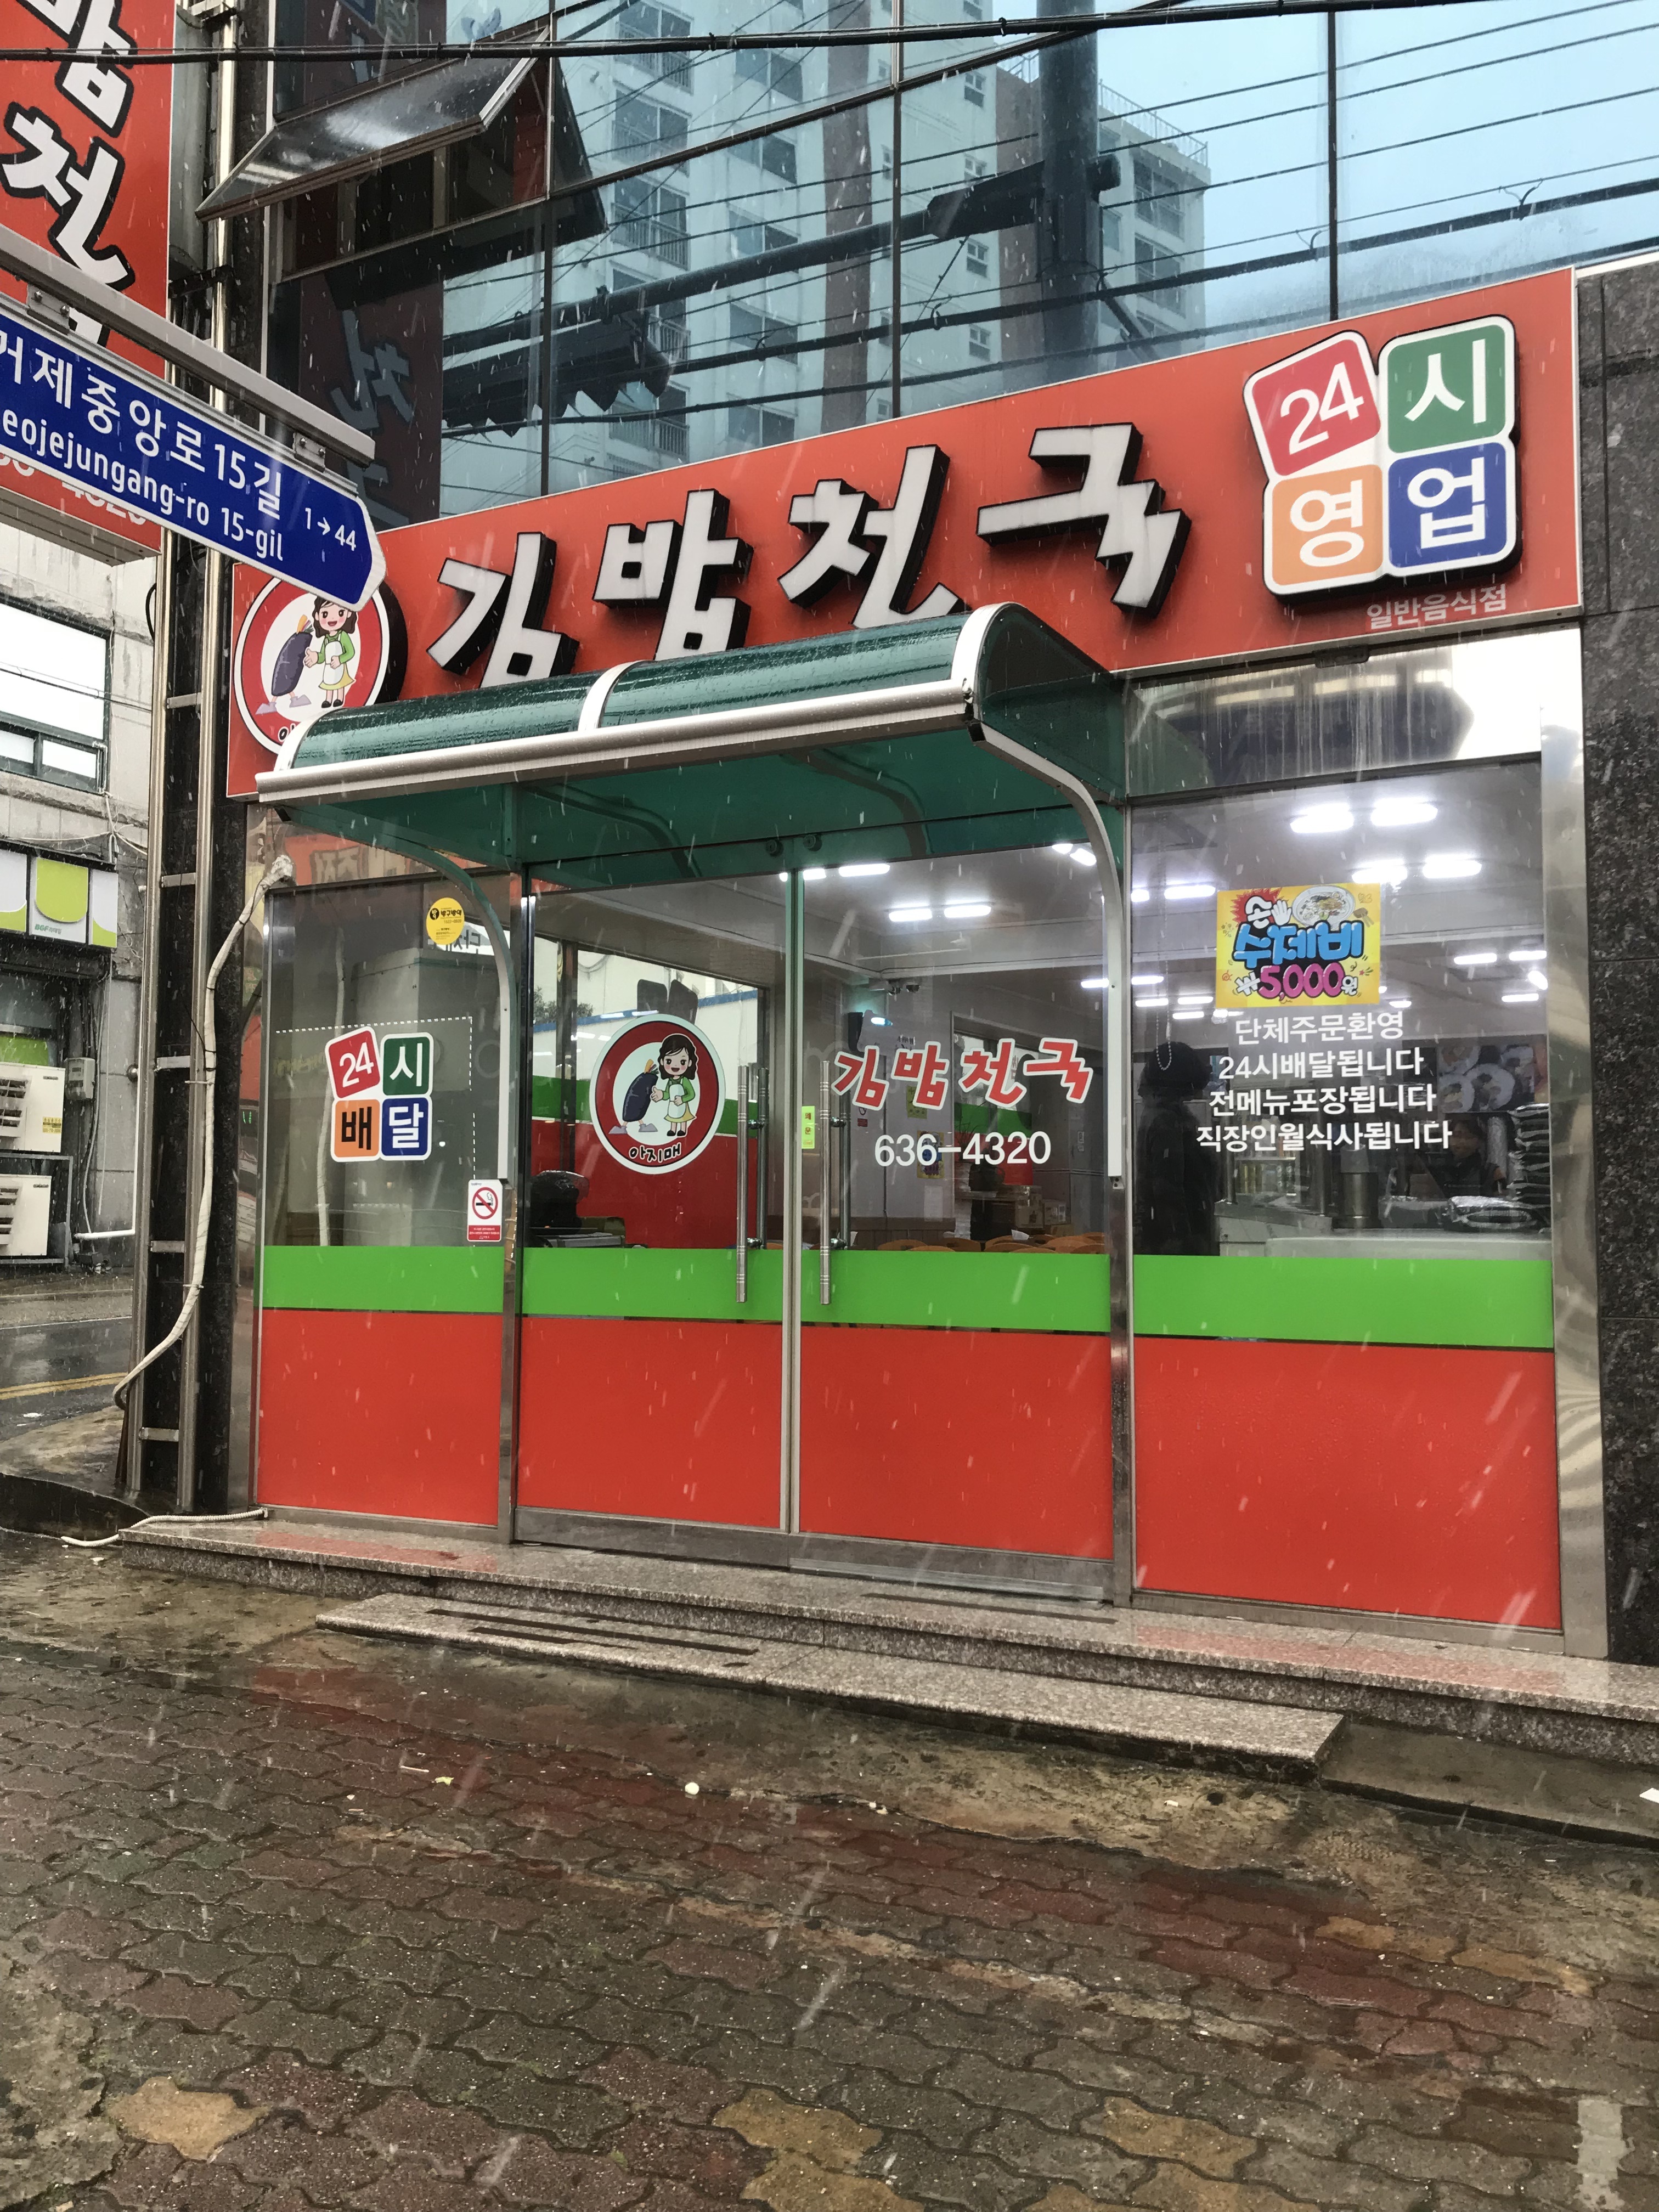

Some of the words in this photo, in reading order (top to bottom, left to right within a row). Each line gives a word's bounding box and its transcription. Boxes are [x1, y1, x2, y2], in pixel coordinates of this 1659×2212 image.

[2, 0, 132, 343] 밥천
[221, 506, 284, 562] 15-gil
[1290, 457, 1485, 567] 영업
[426, 422, 1192, 688] 김밥천국
[1367, 584, 1506, 629] 일반음식점
[1246, 895, 1272, 929] 손
[1234, 922, 1362, 968] 수제비
[1235, 1011, 1403, 1045] 단체주문환영
[832, 1037, 1093, 1110] 김밥천국
[1218, 1048, 1424, 1080] 24시배달됩니다
[1208, 1083, 1437, 1118] 전메뉴포장됩니다
[341, 1103, 424, 1150] 배달
[875, 1131, 1051, 1166] 636-4320
[1196, 1120, 1452, 1152] 직장인월식사됩니다
[629, 1142, 681, 1163] 아지매
